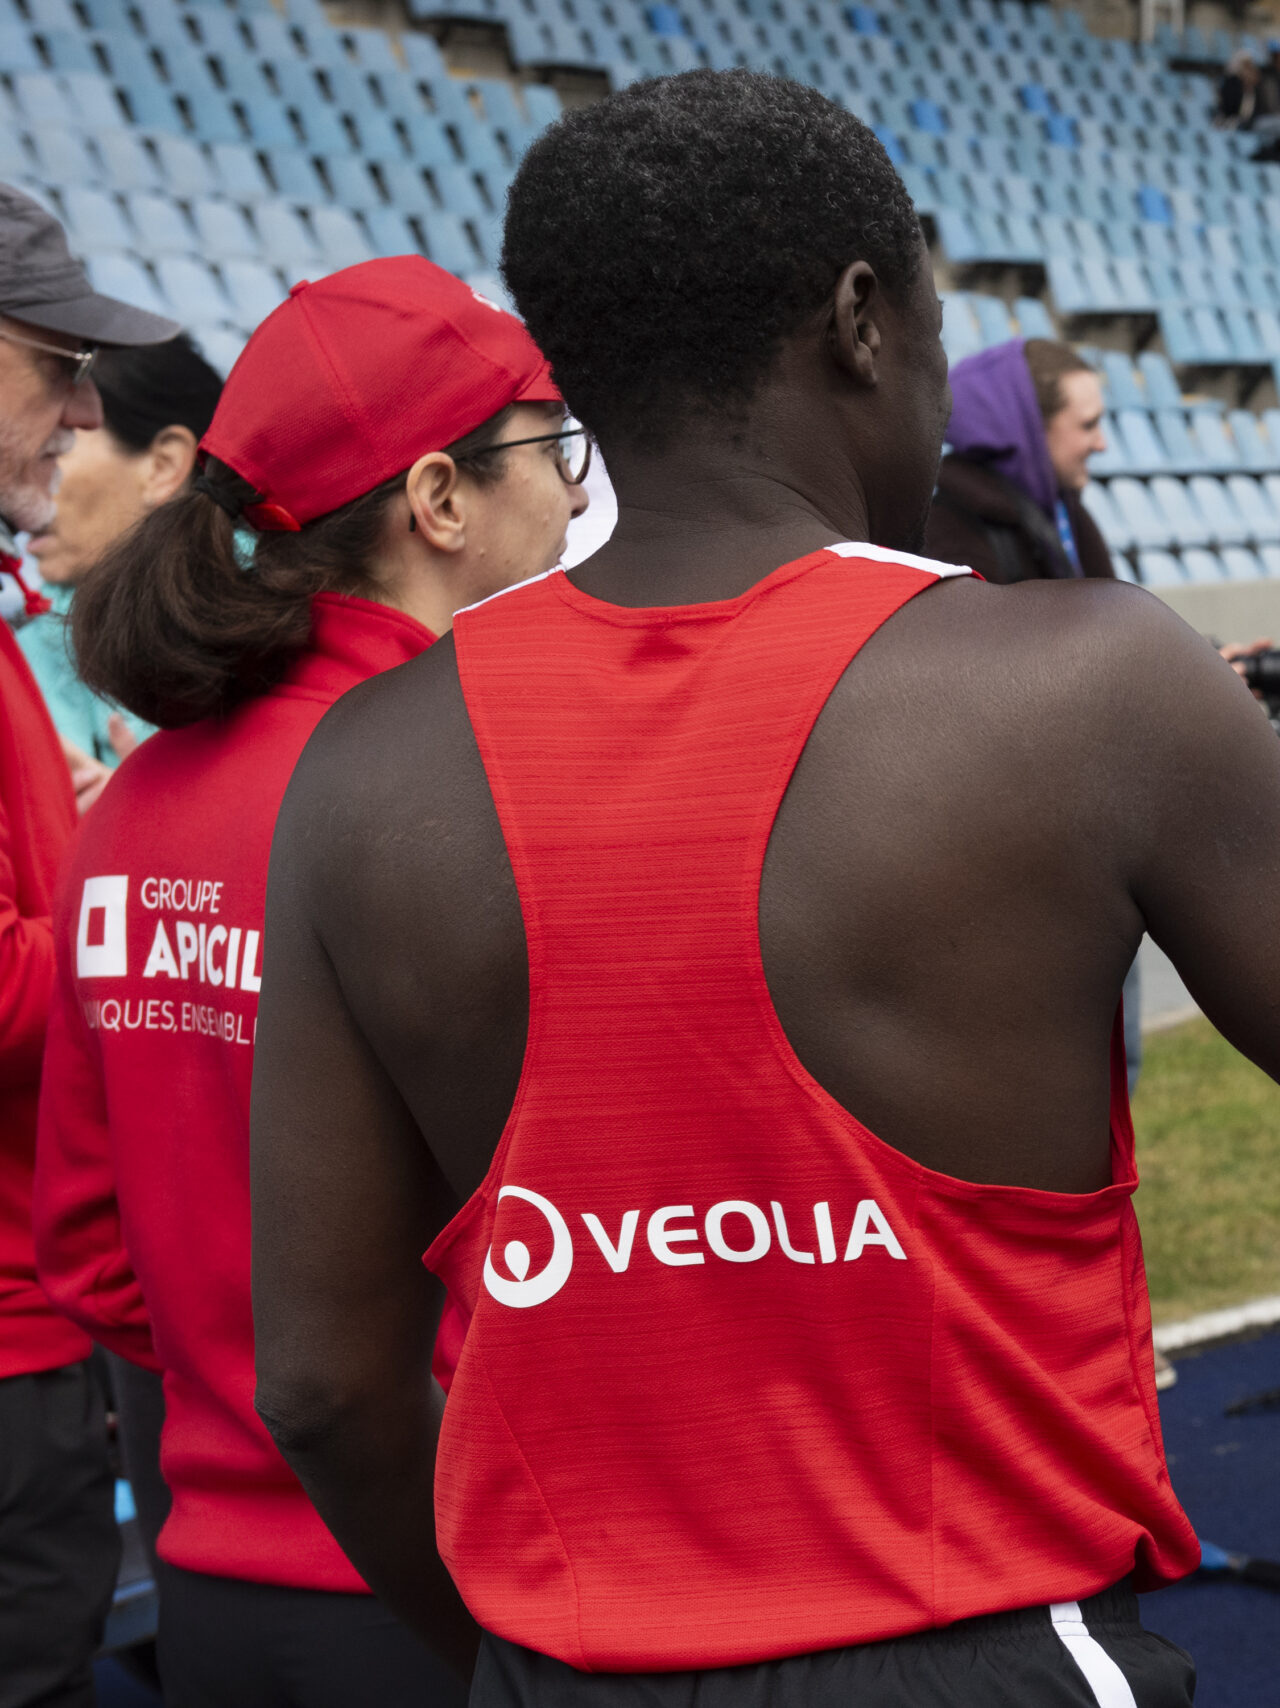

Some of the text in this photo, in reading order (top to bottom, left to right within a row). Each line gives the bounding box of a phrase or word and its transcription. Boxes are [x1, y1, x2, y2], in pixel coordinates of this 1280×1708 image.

[141, 877, 224, 914] GROUPE
[142, 918, 263, 992] APICIL
[181, 1002, 258, 1045] ENSEMBL
[580, 1199, 908, 1273] VEOLIA
